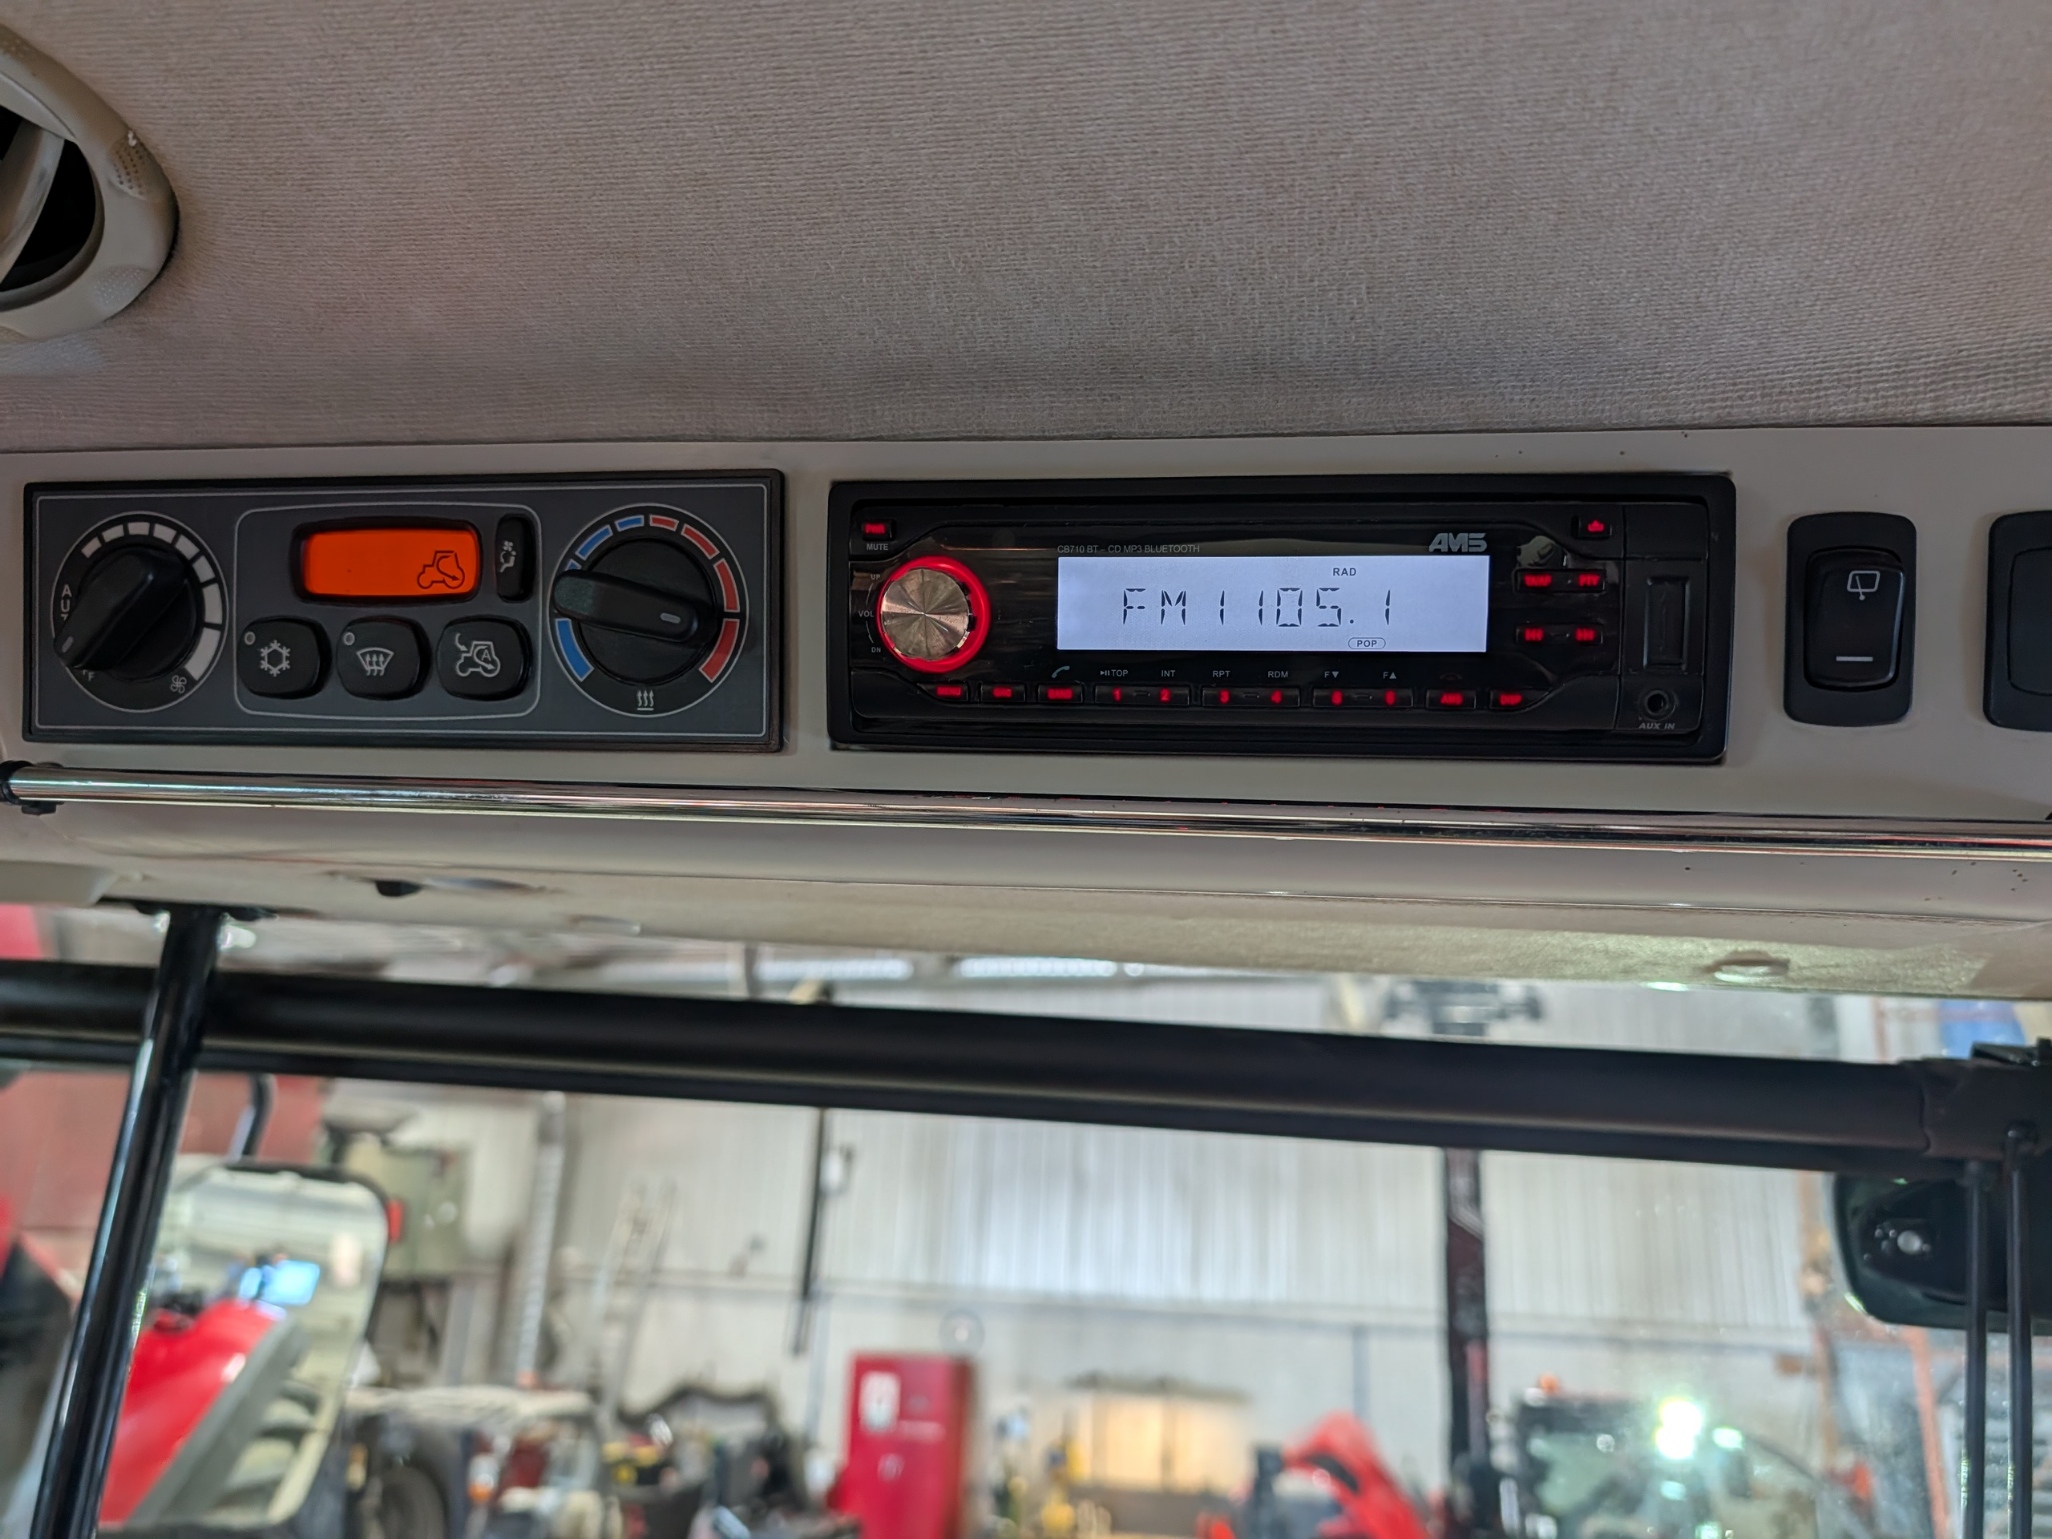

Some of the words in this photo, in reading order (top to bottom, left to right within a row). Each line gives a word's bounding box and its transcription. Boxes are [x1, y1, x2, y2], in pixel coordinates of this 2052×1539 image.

[866, 543, 889, 551] MUTE
[1086, 545, 1099, 554] BT
[1107, 545, 1121, 554] CD
[1123, 545, 1143, 554] MP3
[1144, 544, 1201, 554] BLUETOOTH
[1332, 567, 1358, 577] RAD
[870, 573, 881, 581] UP
[1258, 587, 1391, 627] 105.1
[858, 610, 875, 618] VOL
[1356, 640, 1378, 648] POP
[1111, 669, 1129, 677] TOP
[1161, 669, 1176, 678] INT
[1212, 670, 1231, 678] RPT
[1267, 671, 1289, 679] RDM
[1113, 687, 1121, 702] 1
[1159, 688, 1171, 702] 2
[1219, 690, 1230, 704] 3
[1271, 691, 1282, 704] 4
[1639, 722, 1660, 730] AUX
[1664, 722, 1676, 730] IN
